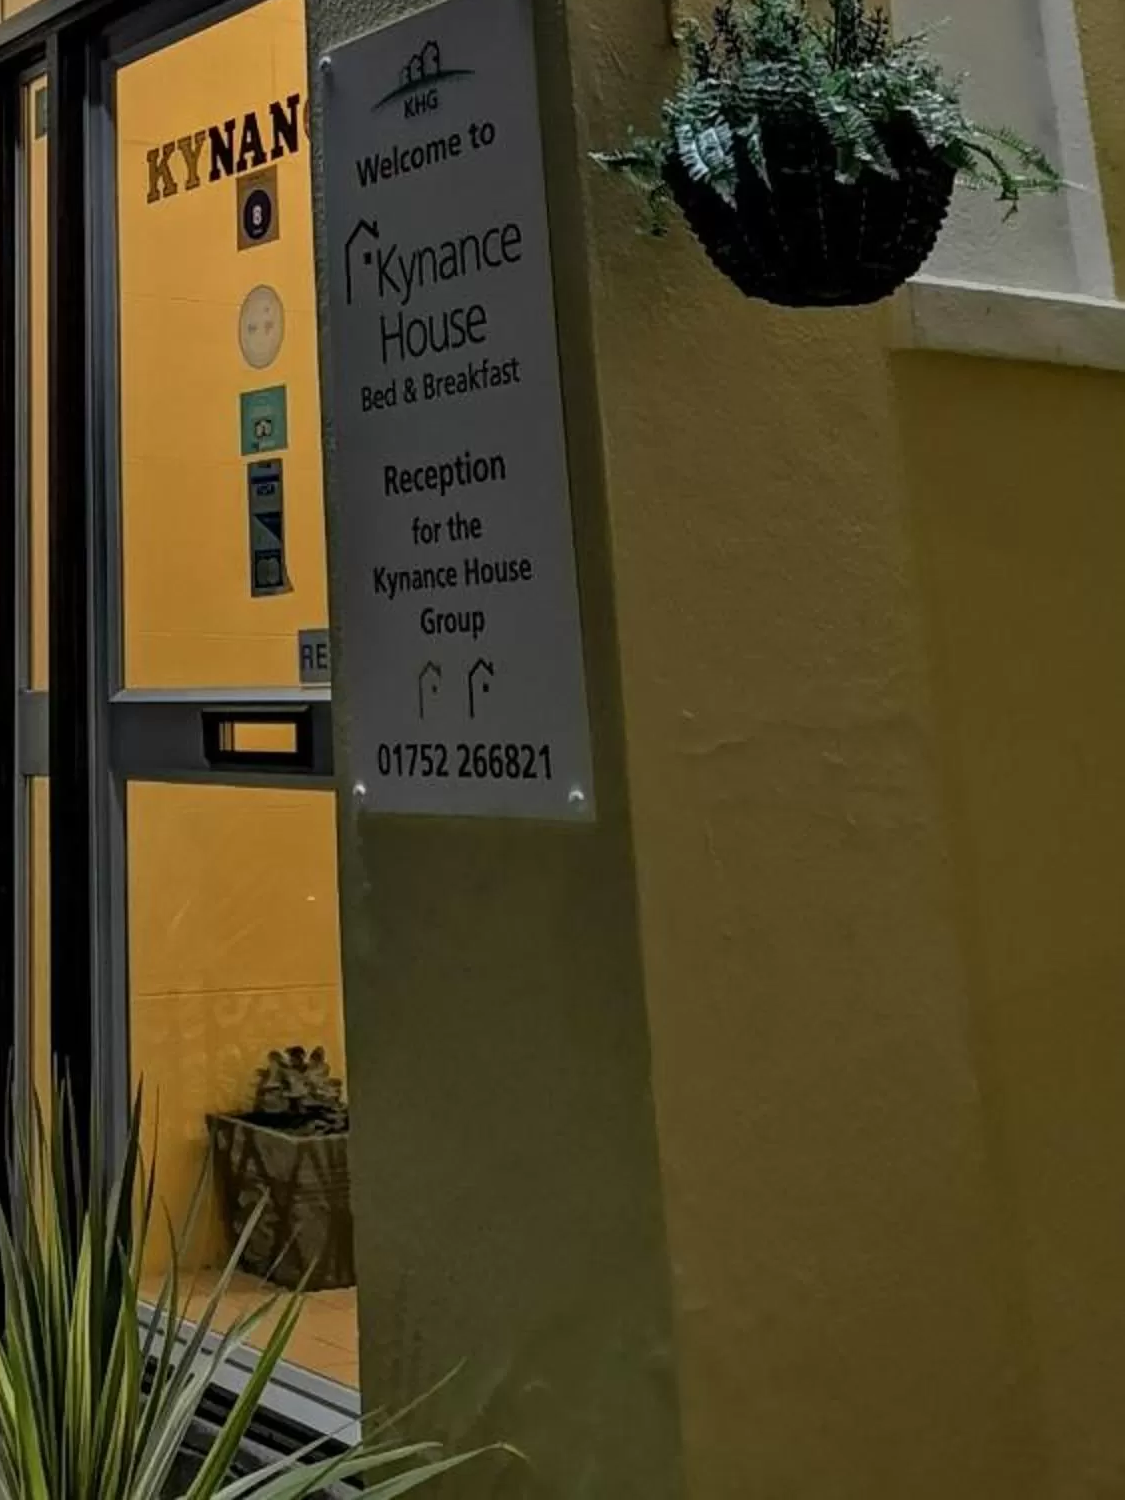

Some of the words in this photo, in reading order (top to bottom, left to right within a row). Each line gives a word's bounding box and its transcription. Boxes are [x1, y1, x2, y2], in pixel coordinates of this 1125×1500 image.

[404, 89, 439, 119] KHG
[146, 92, 310, 204] KYNAN
[355, 131, 462, 188] Welcome
[470, 120, 496, 150] to
[376, 221, 523, 306] Kynance
[379, 303, 488, 364] House
[361, 382, 397, 413] Bed
[403, 378, 418, 404] &
[422, 356, 521, 401] Breakfast
[383, 450, 507, 498] Reception
[412, 515, 442, 545] for
[447, 512, 483, 541] the
[373, 560, 458, 601] Kynance
[464, 555, 533, 587] House
[419, 606, 485, 641] Group
[377, 743, 449, 778] 01752
[457, 744, 552, 781] 266821
